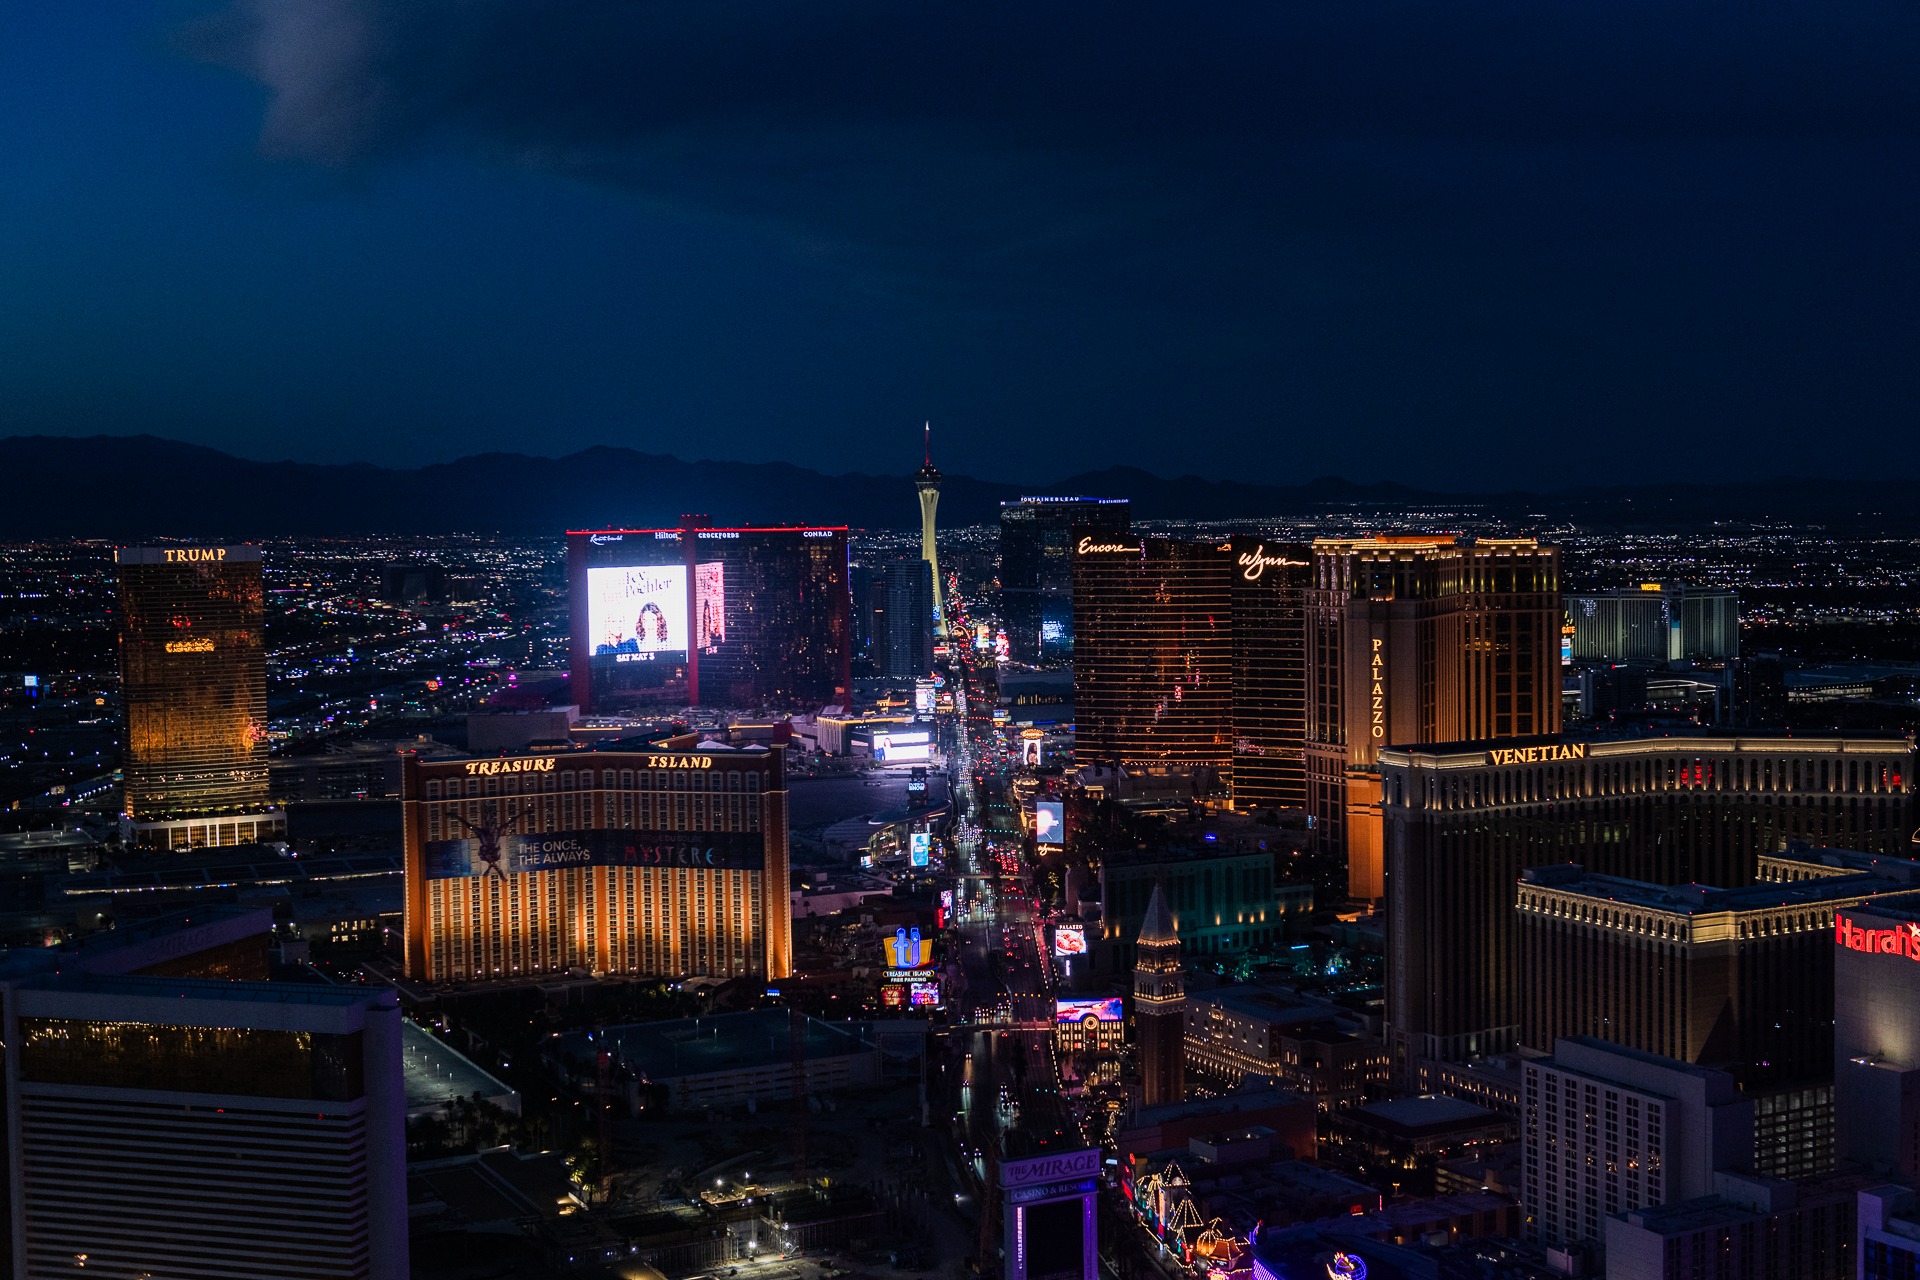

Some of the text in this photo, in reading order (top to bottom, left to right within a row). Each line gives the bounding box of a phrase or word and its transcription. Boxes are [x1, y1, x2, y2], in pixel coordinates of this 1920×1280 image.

[163, 548, 226, 562] TRUMP
[1078, 536, 1141, 555] Encore
[1371, 638, 1384, 738] PALAZZO
[1489, 743, 1585, 766] VENETIAN
[465, 755, 712, 775] TREASURE ISLAND
[518, 843, 540, 854] THE
[518, 848, 591, 866] THE ALWAYS
[1008, 1154, 1097, 1181] THE MIRAGE
[1014, 1187, 1049, 1200] CASINO
[1050, 1186, 1057, 1194] &
